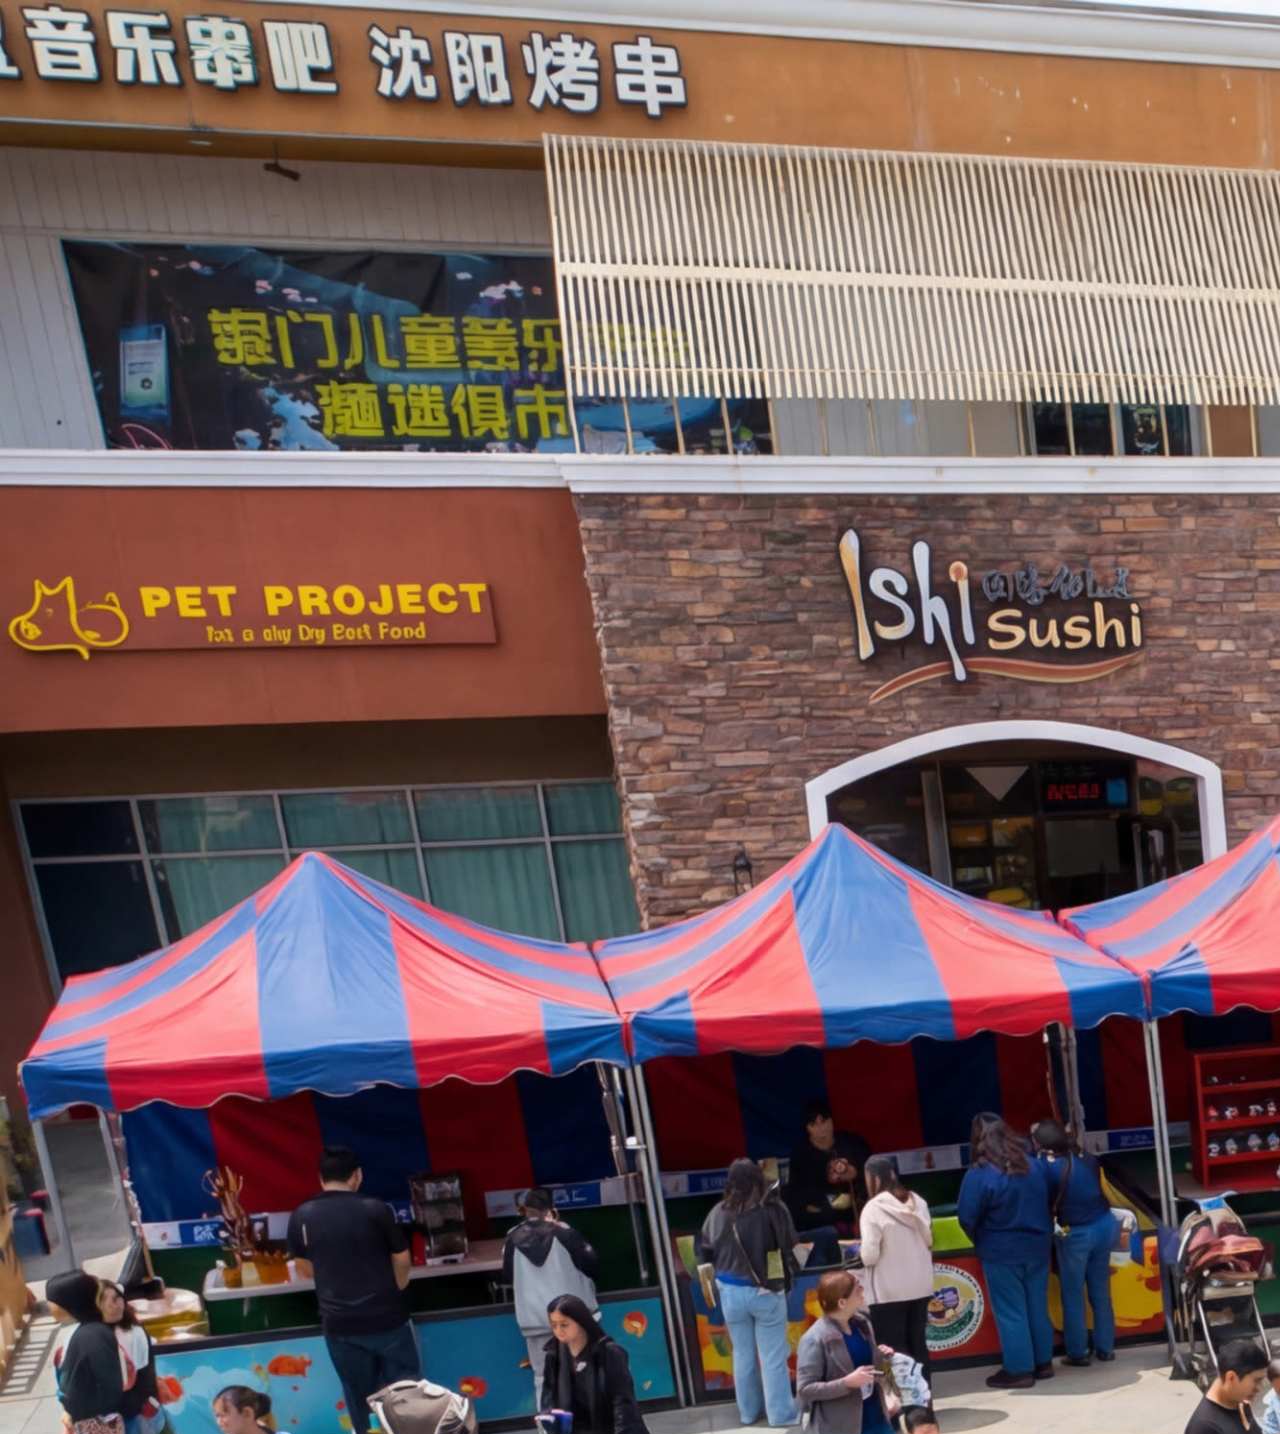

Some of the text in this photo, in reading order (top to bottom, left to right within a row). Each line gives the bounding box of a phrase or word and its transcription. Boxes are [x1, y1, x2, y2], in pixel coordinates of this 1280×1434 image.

[367, 23, 688, 119] 沈阳烤串
[139, 582, 487, 617] PET PROJECT
[838, 527, 976, 682] Ishi
[986, 600, 1143, 651] Sushi
